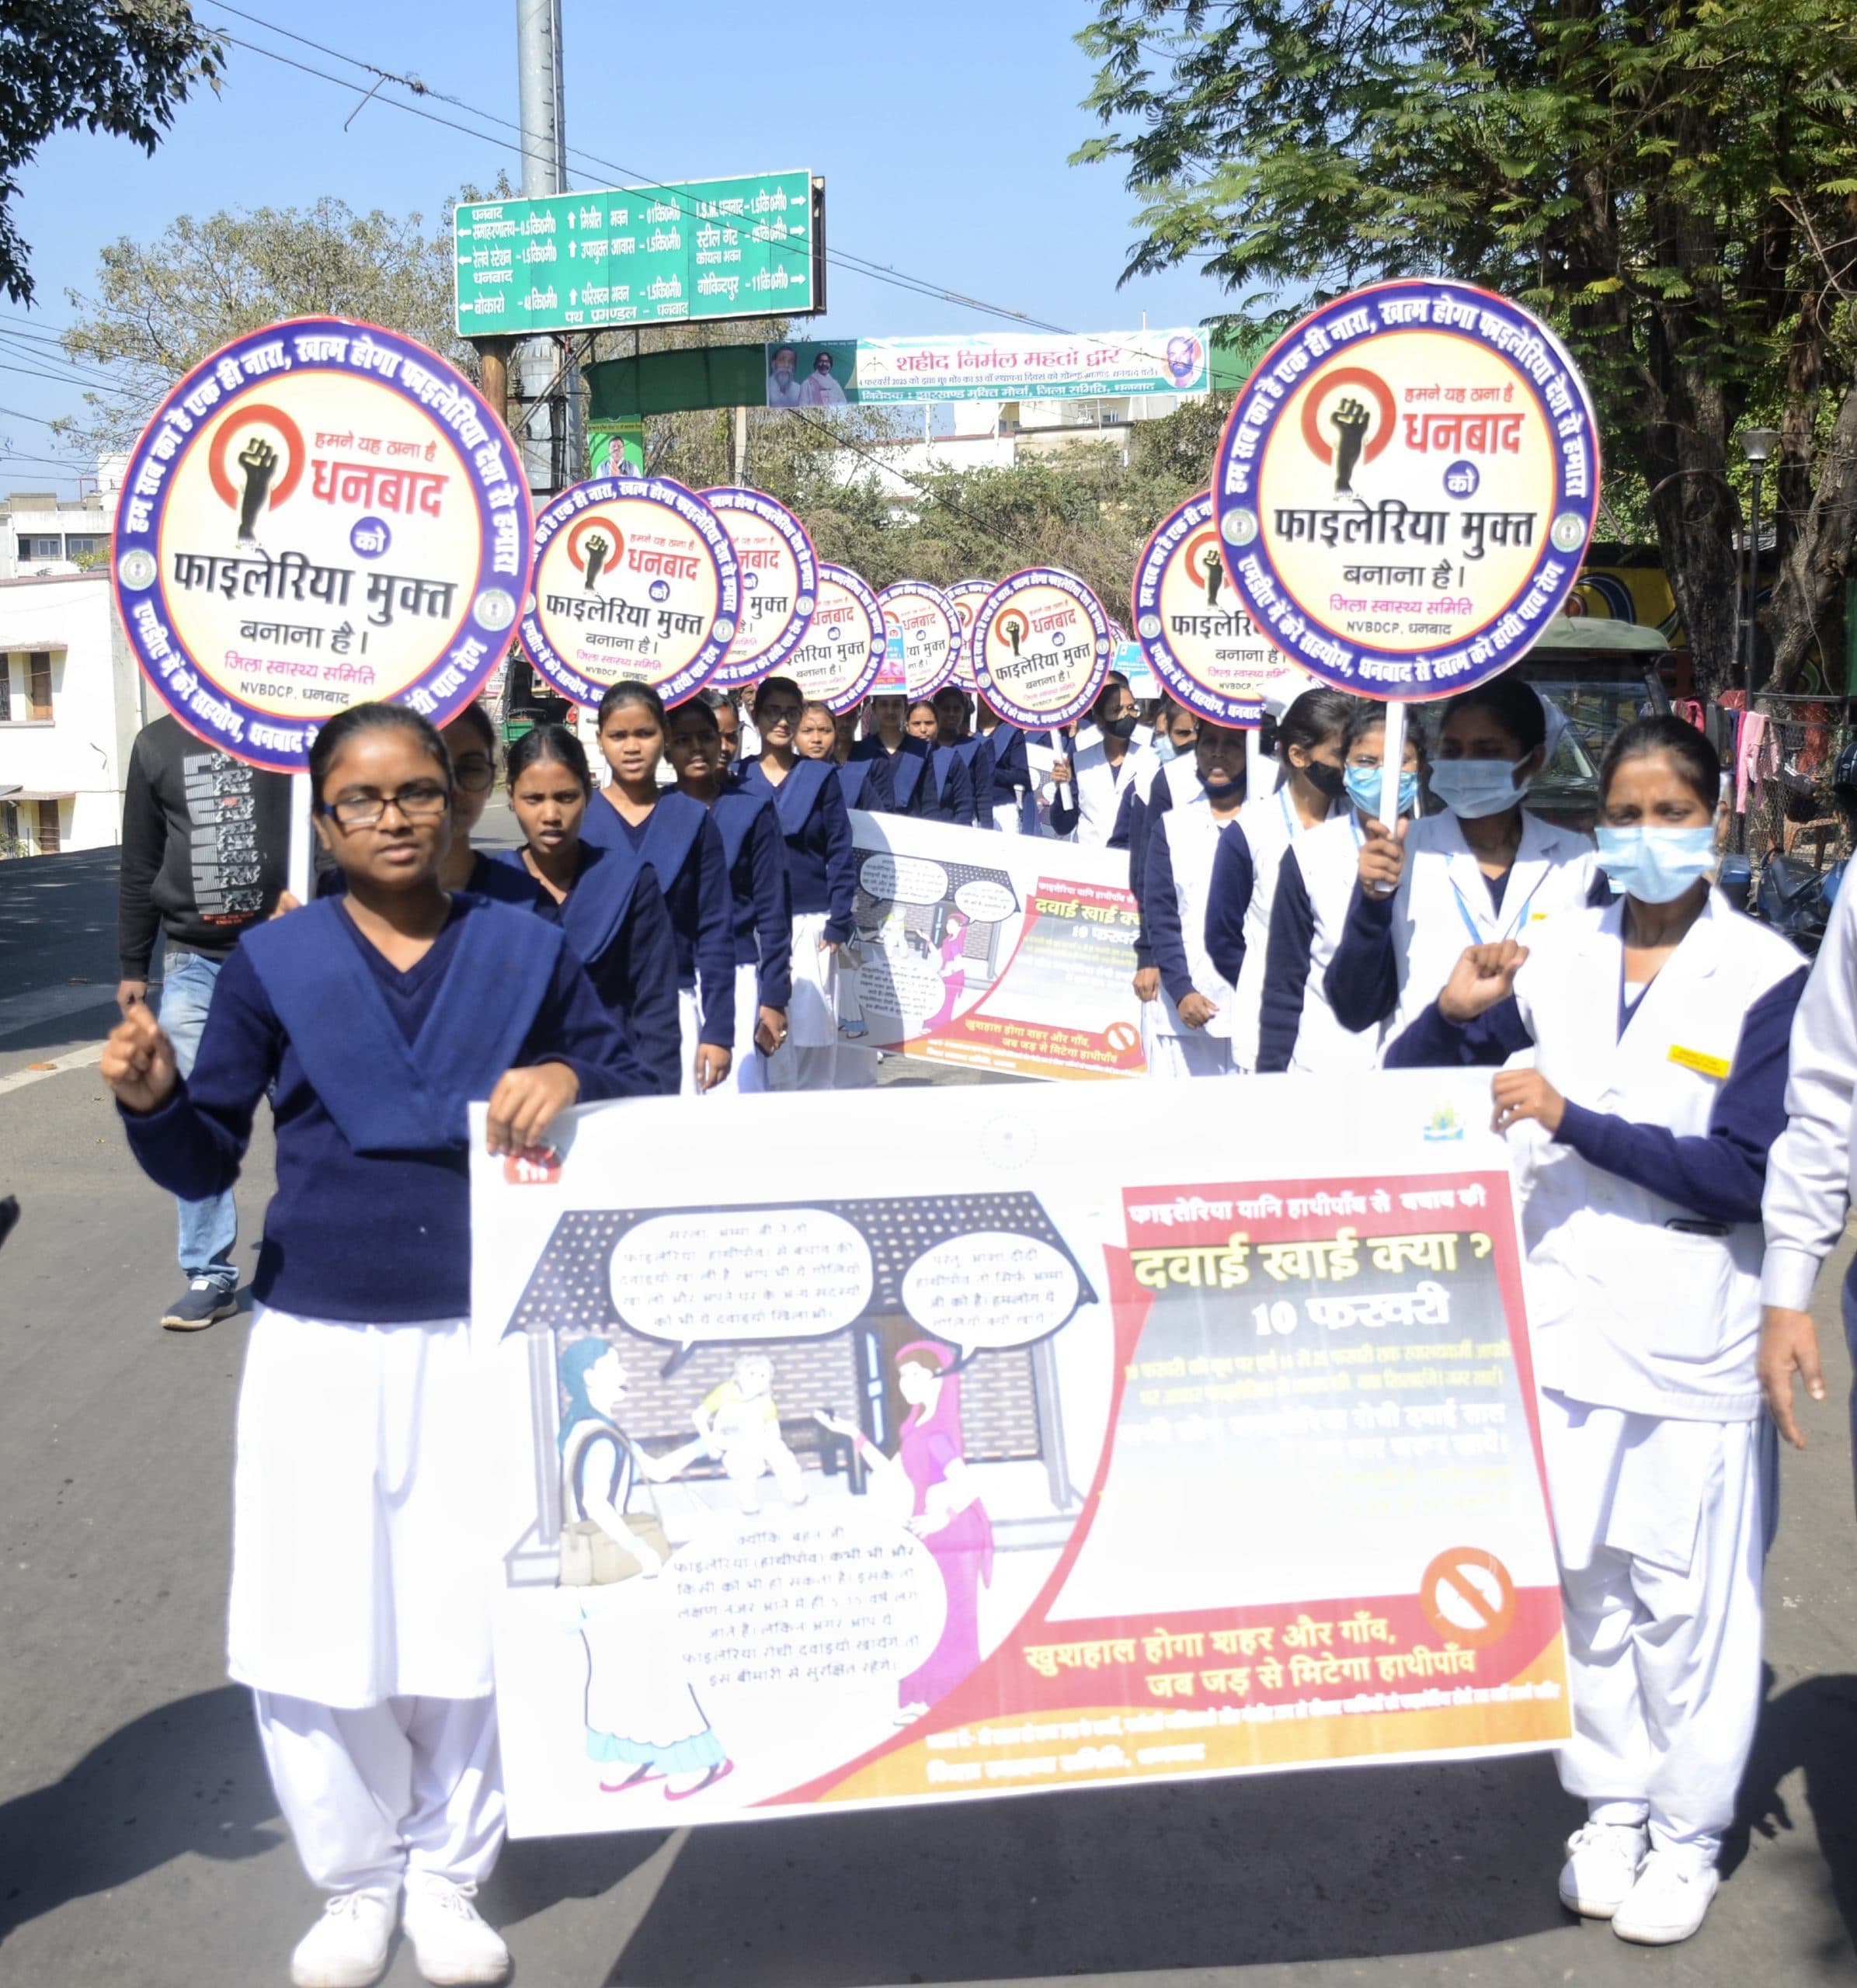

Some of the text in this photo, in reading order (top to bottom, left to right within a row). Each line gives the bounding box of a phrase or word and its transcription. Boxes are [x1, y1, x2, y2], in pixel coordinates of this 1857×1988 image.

[610, 209, 628, 227] भवन
[611, 238, 635, 255] आवास
[696, 248, 741, 265] कोयला भवन
[473, 270, 513, 284] धनबाद
[474, 290, 505, 315] बोकारो
[611, 286, 630, 303] भवन
[565, 311, 583, 323] पथ
[1431, 293, 1480, 331] होगा
[350, 334, 403, 379] होगा
[896, 346, 1121, 371] शहीद निर्मल महतो द्वार
[1405, 384, 1441, 402] हमने
[1445, 388, 1466, 403] यह
[1503, 383, 1514, 402] है
[1403, 412, 1525, 454] धनबाद
[315, 430, 353, 450] हमने
[357, 436, 381, 456] यह
[424, 440, 438, 463] है
[311, 459, 450, 519] धनबाद
[1448, 468, 1475, 492] को
[354, 525, 388, 554] को
[1274, 499, 1538, 561] फाइलेरिया मुक्त
[628, 547, 701, 582] धनबाद
[1343, 565, 1426, 587] बनाना
[174, 547, 458, 627] फाइलेरिया मुक्त
[547, 593, 705, 639] फाइलेरिया मुक्त
[750, 595, 789, 620] मुक्त
[1330, 593, 1473, 616] जिला स्वास्थ्य समिति
[1031, 608, 1078, 634] धनबाद
[1408, 623, 1452, 635] धनबाद
[239, 619, 325, 650] बनाना
[585, 632, 635, 652] बनाना
[836, 641, 865, 662] मुक्त
[995, 642, 1090, 681] फाइलेरिया मुक्त
[1215, 649, 1264, 662] बनाना
[224, 649, 377, 686] जिला स्वास्थ्य समिति
[301, 688, 350, 706] धनबाद
[1035, 897, 1080, 919] दवाई
[1080, 904, 1119, 925] खाई
[1003, 1023, 1025, 1037] होगा
[1050, 1031, 1069, 1045] और
[1371, 1189, 1391, 1214] से
[1457, 1183, 1487, 1208] की
[1129, 1232, 1250, 1289] दवाई
[1257, 1226, 1359, 1282] खाई
[1366, 1232, 1459, 1274] क्या
[1251, 1281, 1451, 1336] 10 फरवरी
[1023, 1611, 1396, 1677] खुशहाल होगा शहर और गाँव,
[1145, 1642, 1476, 1698] जब जड़ से मिटेगा हाथीपाँव
